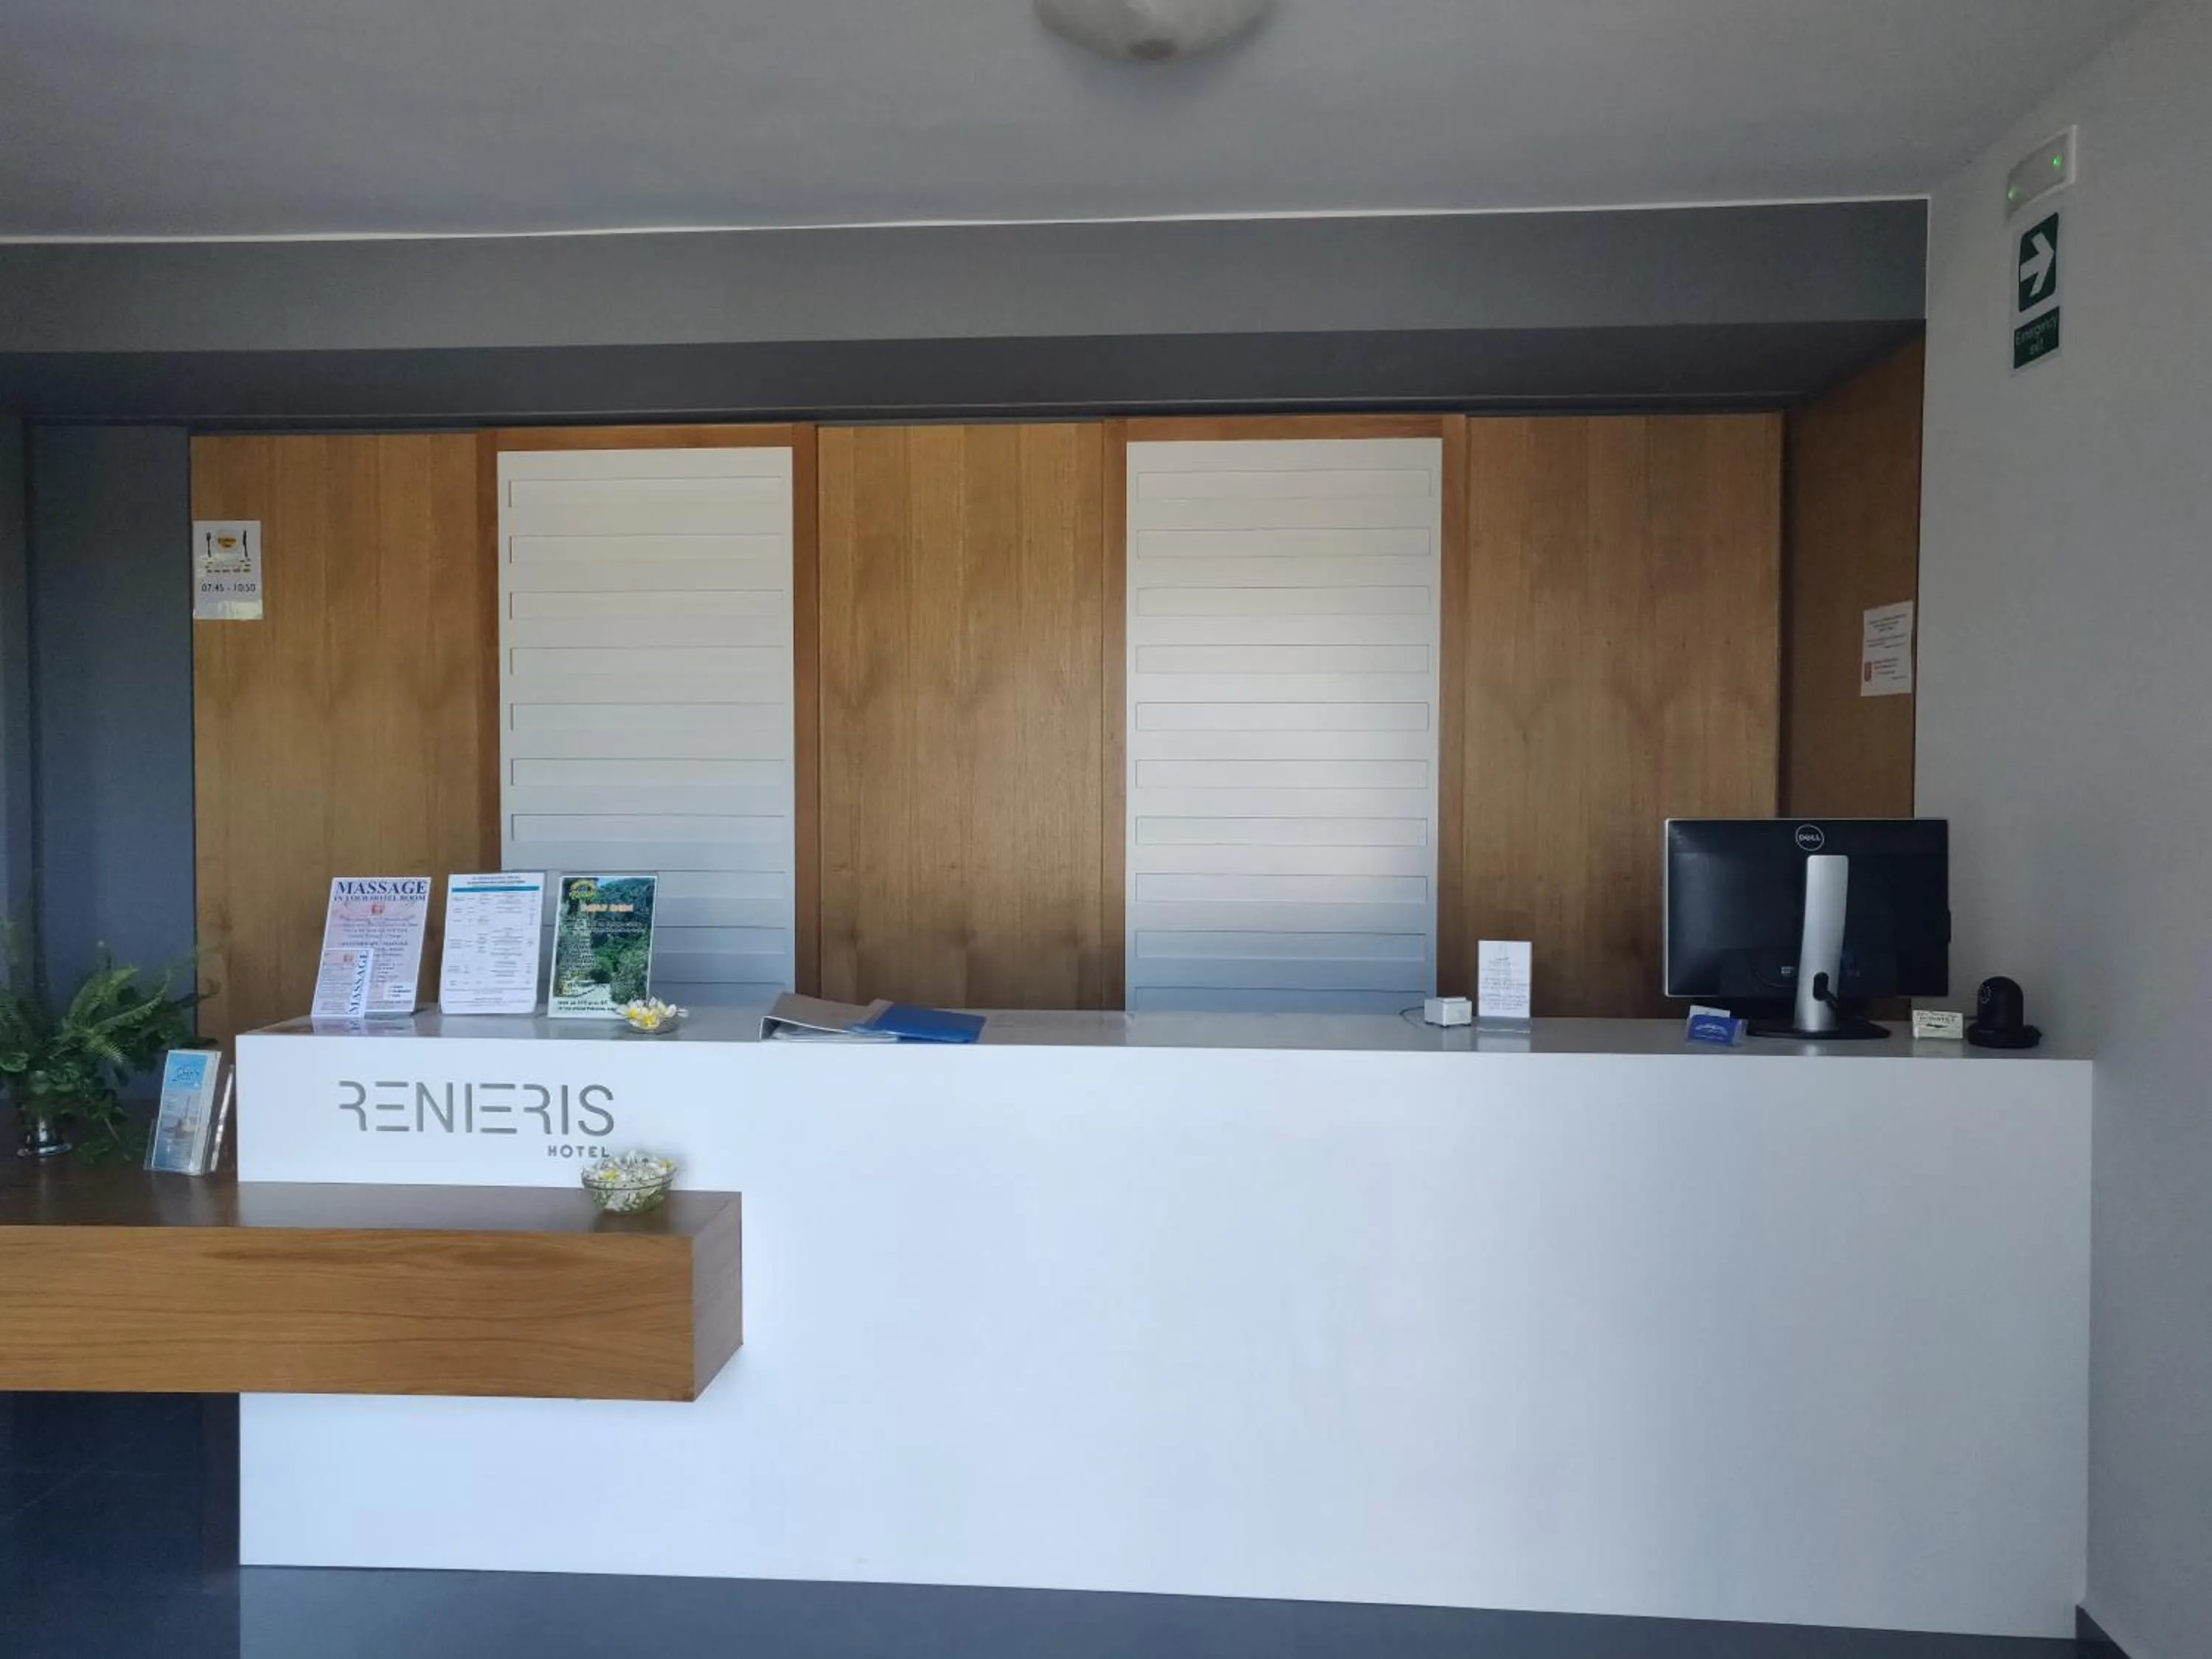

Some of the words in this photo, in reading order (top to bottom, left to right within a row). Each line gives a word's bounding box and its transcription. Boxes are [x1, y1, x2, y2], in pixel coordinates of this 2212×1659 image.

[335, 881, 428, 894] MASSAGE
[347, 950, 369, 1013] MASSAGE
[338, 1080, 614, 1136] RENIERIS
[547, 1144, 611, 1158] HOTEL
